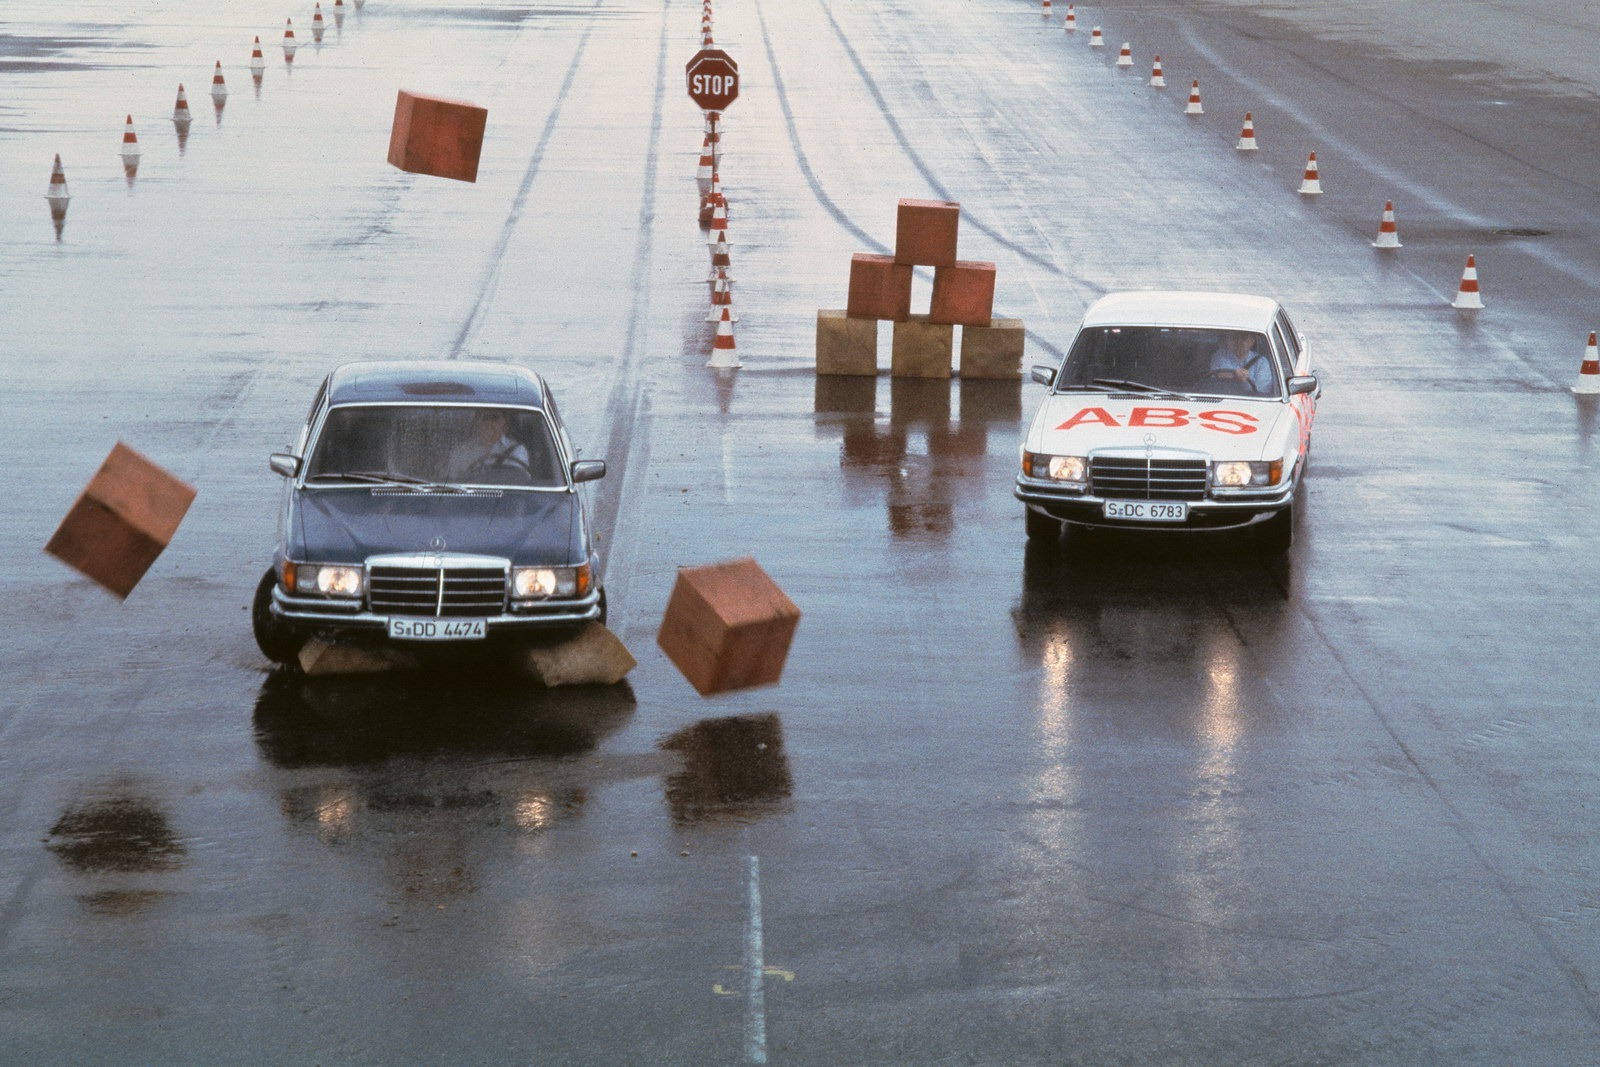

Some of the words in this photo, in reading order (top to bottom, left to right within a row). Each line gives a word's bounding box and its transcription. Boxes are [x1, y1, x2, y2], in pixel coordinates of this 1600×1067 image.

[693, 74, 734, 95] STOP
[1150, 505, 1182, 518] 6783
[444, 622, 482, 636] 4474
